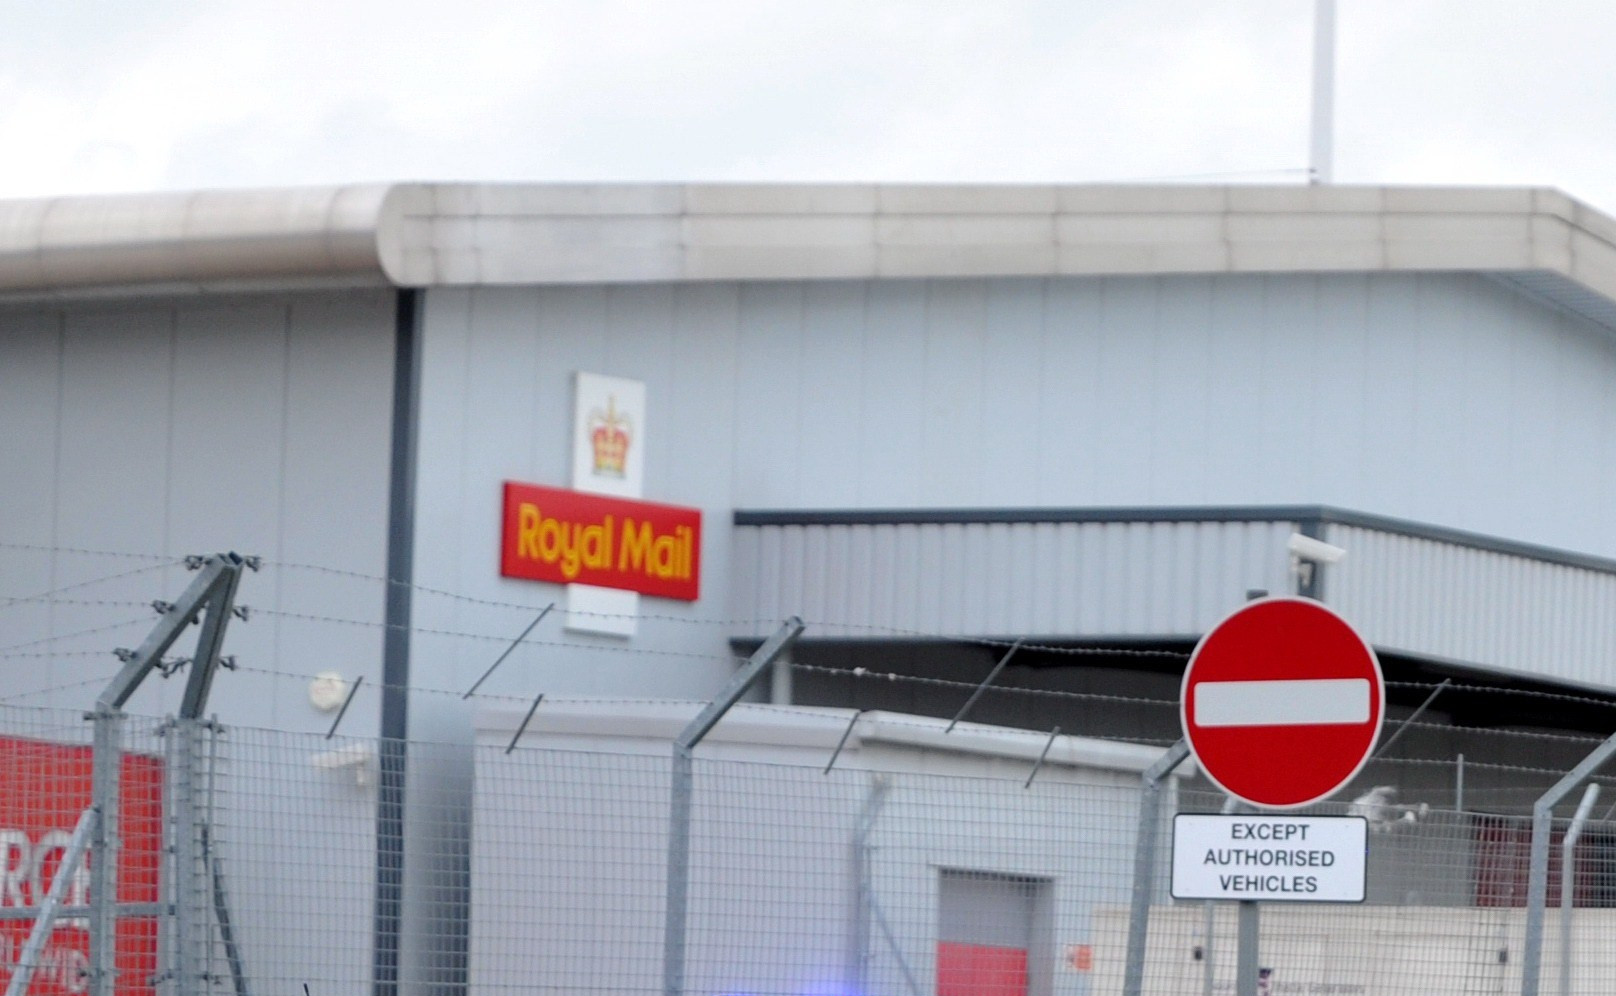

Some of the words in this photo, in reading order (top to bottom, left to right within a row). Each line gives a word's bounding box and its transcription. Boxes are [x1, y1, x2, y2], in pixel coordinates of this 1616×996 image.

[517, 502, 614, 578] Royal
[618, 517, 694, 580] Mail
[1231, 823, 1310, 841] EXCEPT
[1203, 848, 1336, 868] AUTHORISED
[1219, 874, 1318, 893] VEHICLES
